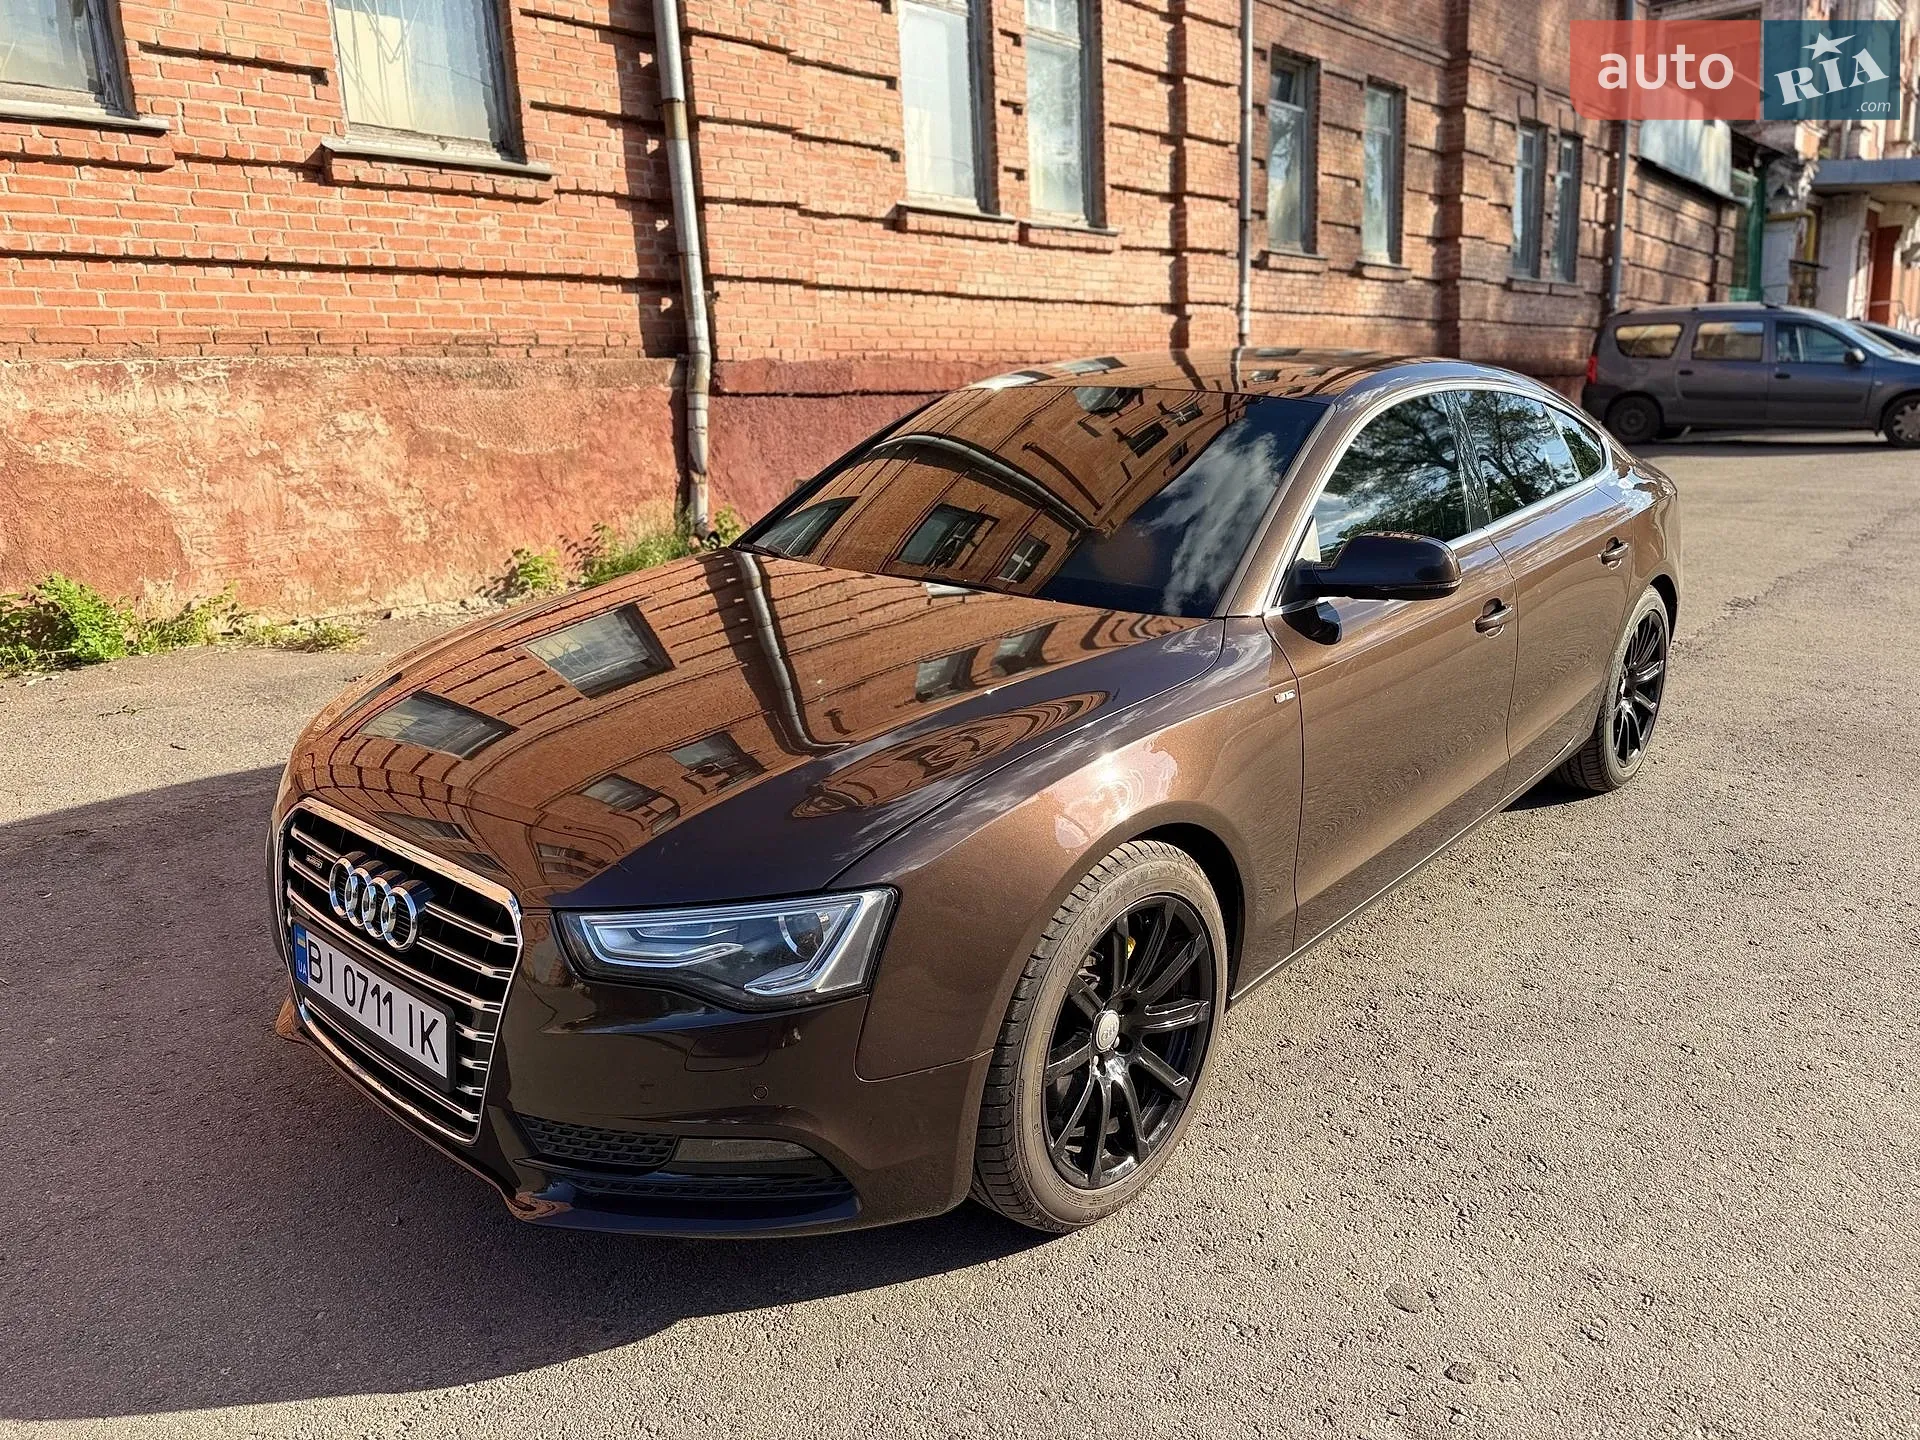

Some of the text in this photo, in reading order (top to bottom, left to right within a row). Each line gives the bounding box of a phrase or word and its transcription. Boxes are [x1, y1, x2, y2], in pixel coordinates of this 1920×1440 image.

[297, 960, 307, 975] UA
[308, 939, 440, 1065] BI 0711 IK
